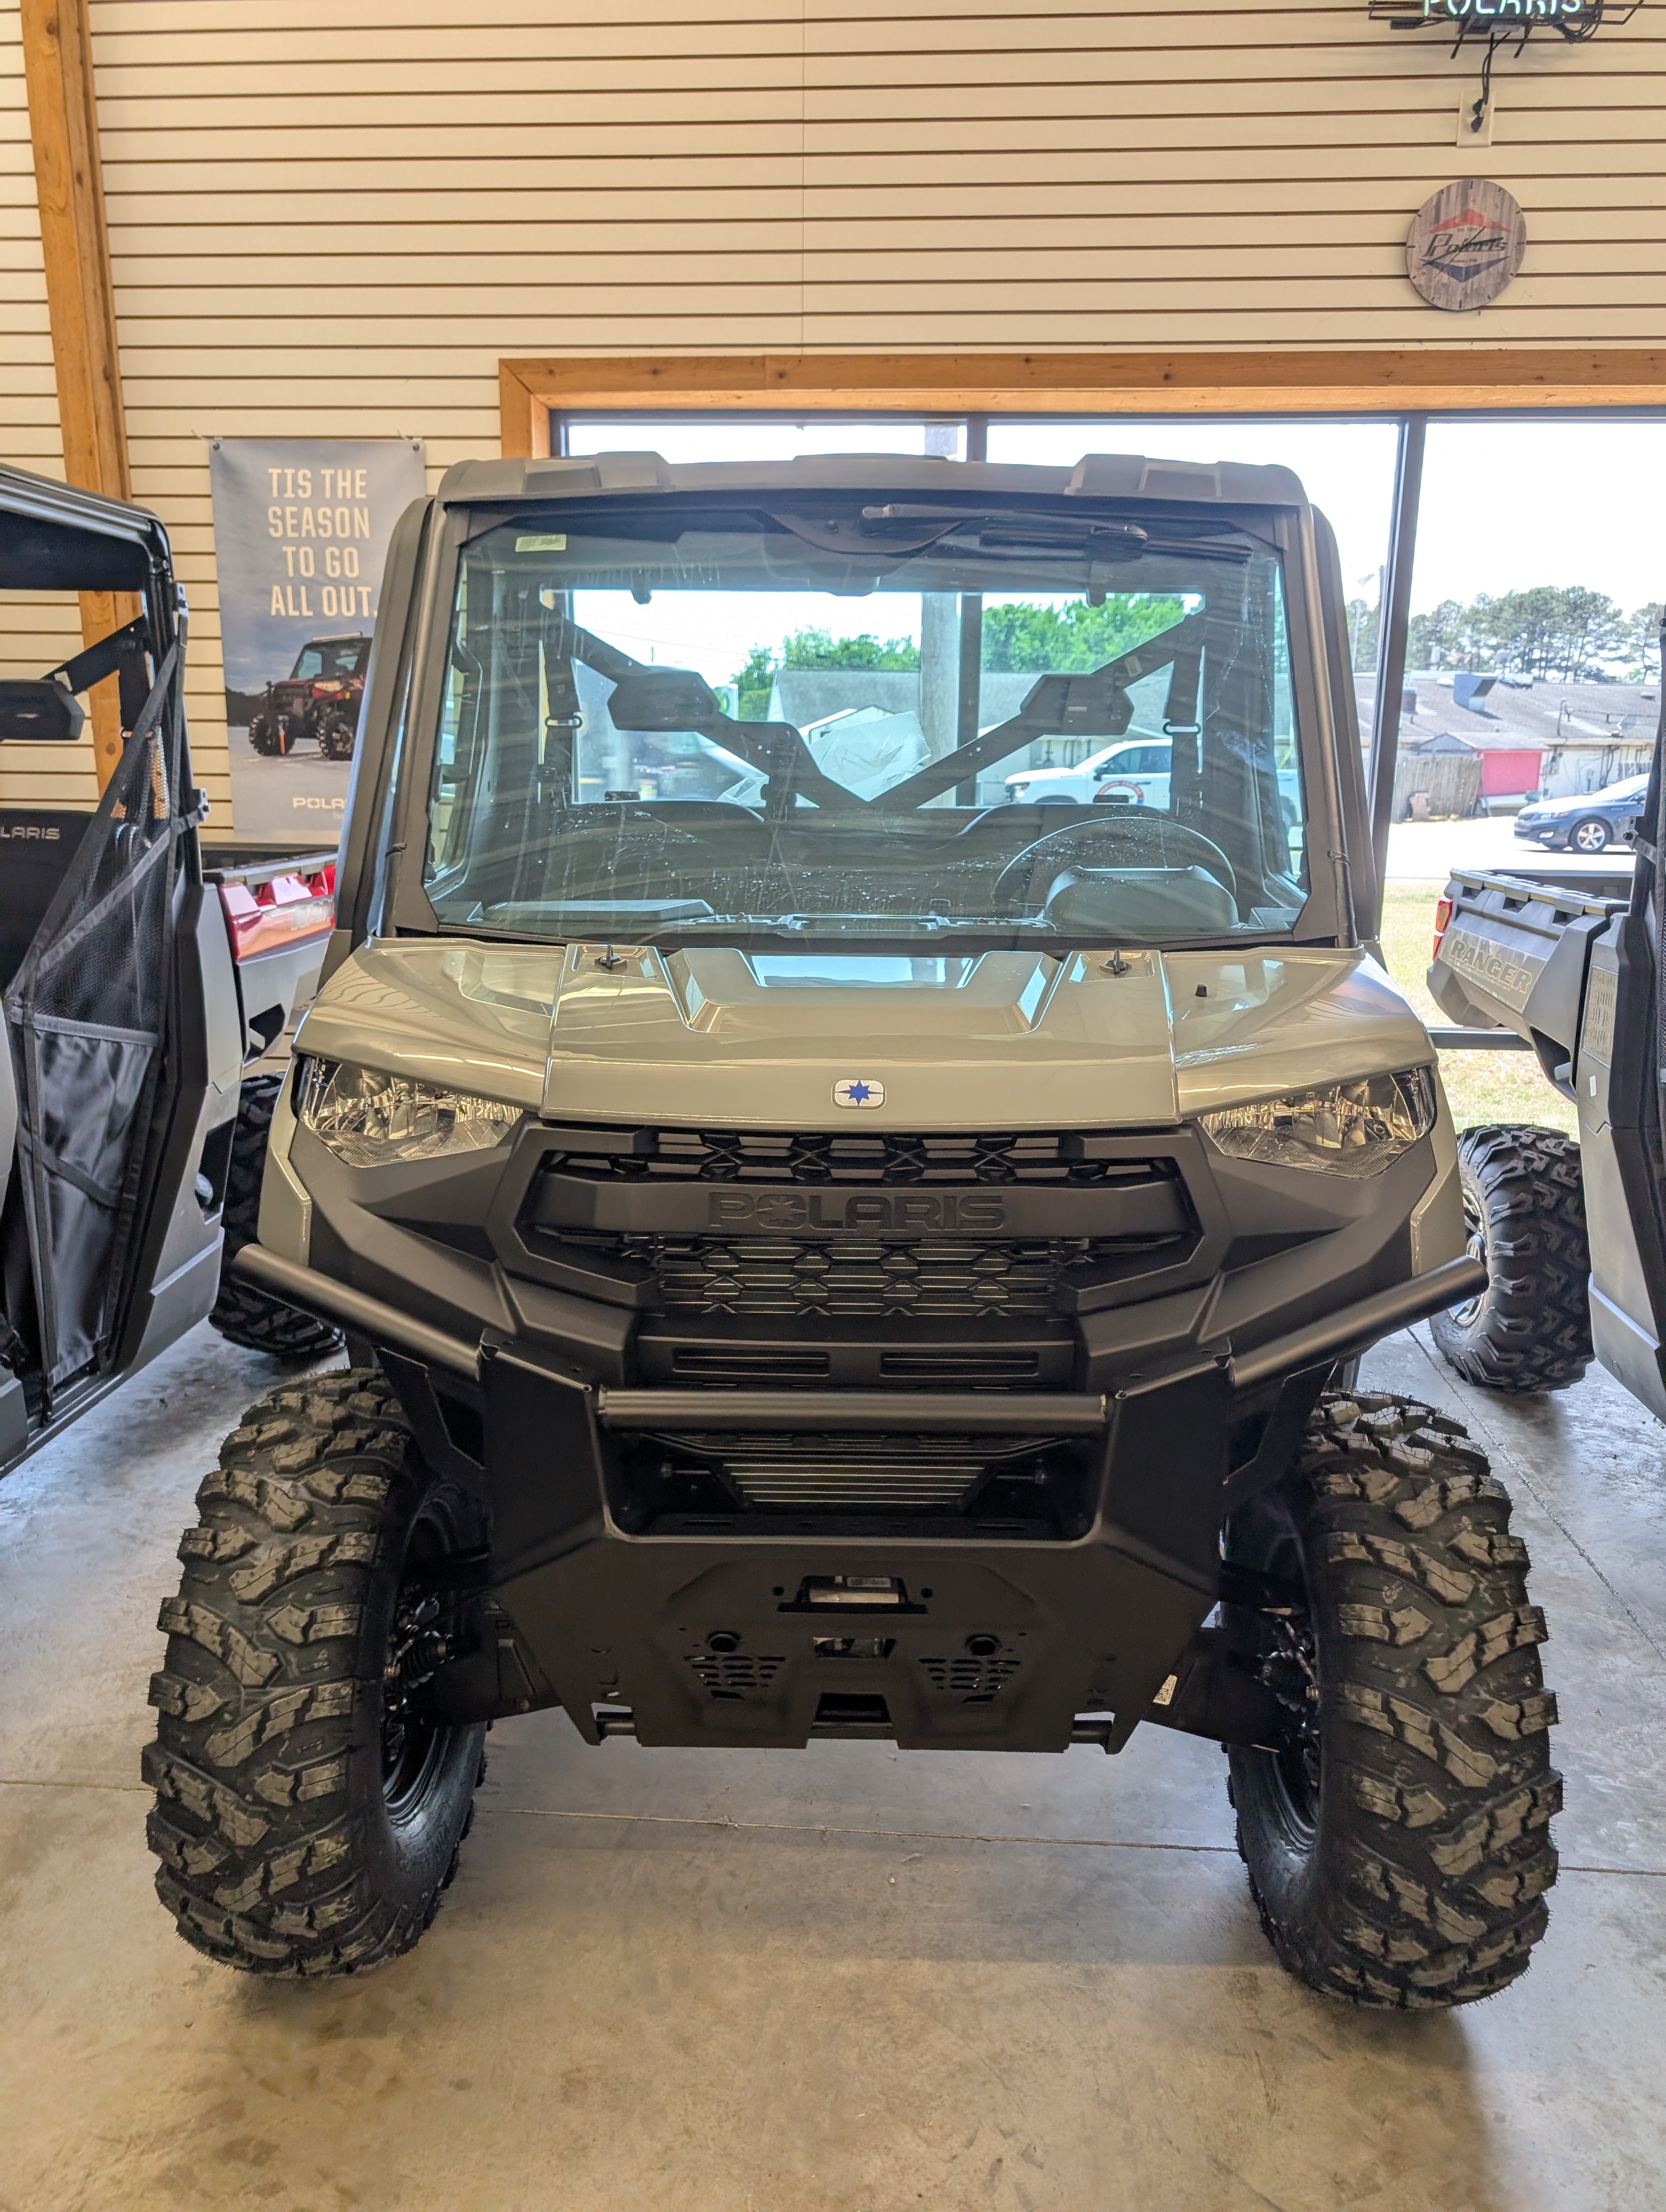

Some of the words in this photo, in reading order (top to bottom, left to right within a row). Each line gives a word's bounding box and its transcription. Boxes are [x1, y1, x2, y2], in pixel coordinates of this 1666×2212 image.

[268, 468, 312, 498] TIS
[321, 469, 368, 499] THE
[268, 506, 370, 538] SEASON
[282, 546, 315, 577] TO
[325, 546, 360, 578] GO
[271, 585, 313, 616] ALL
[322, 586, 377, 617] OUT.
[293, 798, 347, 809] POLA
[1450, 940, 1533, 994] RANGER
[709, 1192, 1006, 1231] POLARIS
